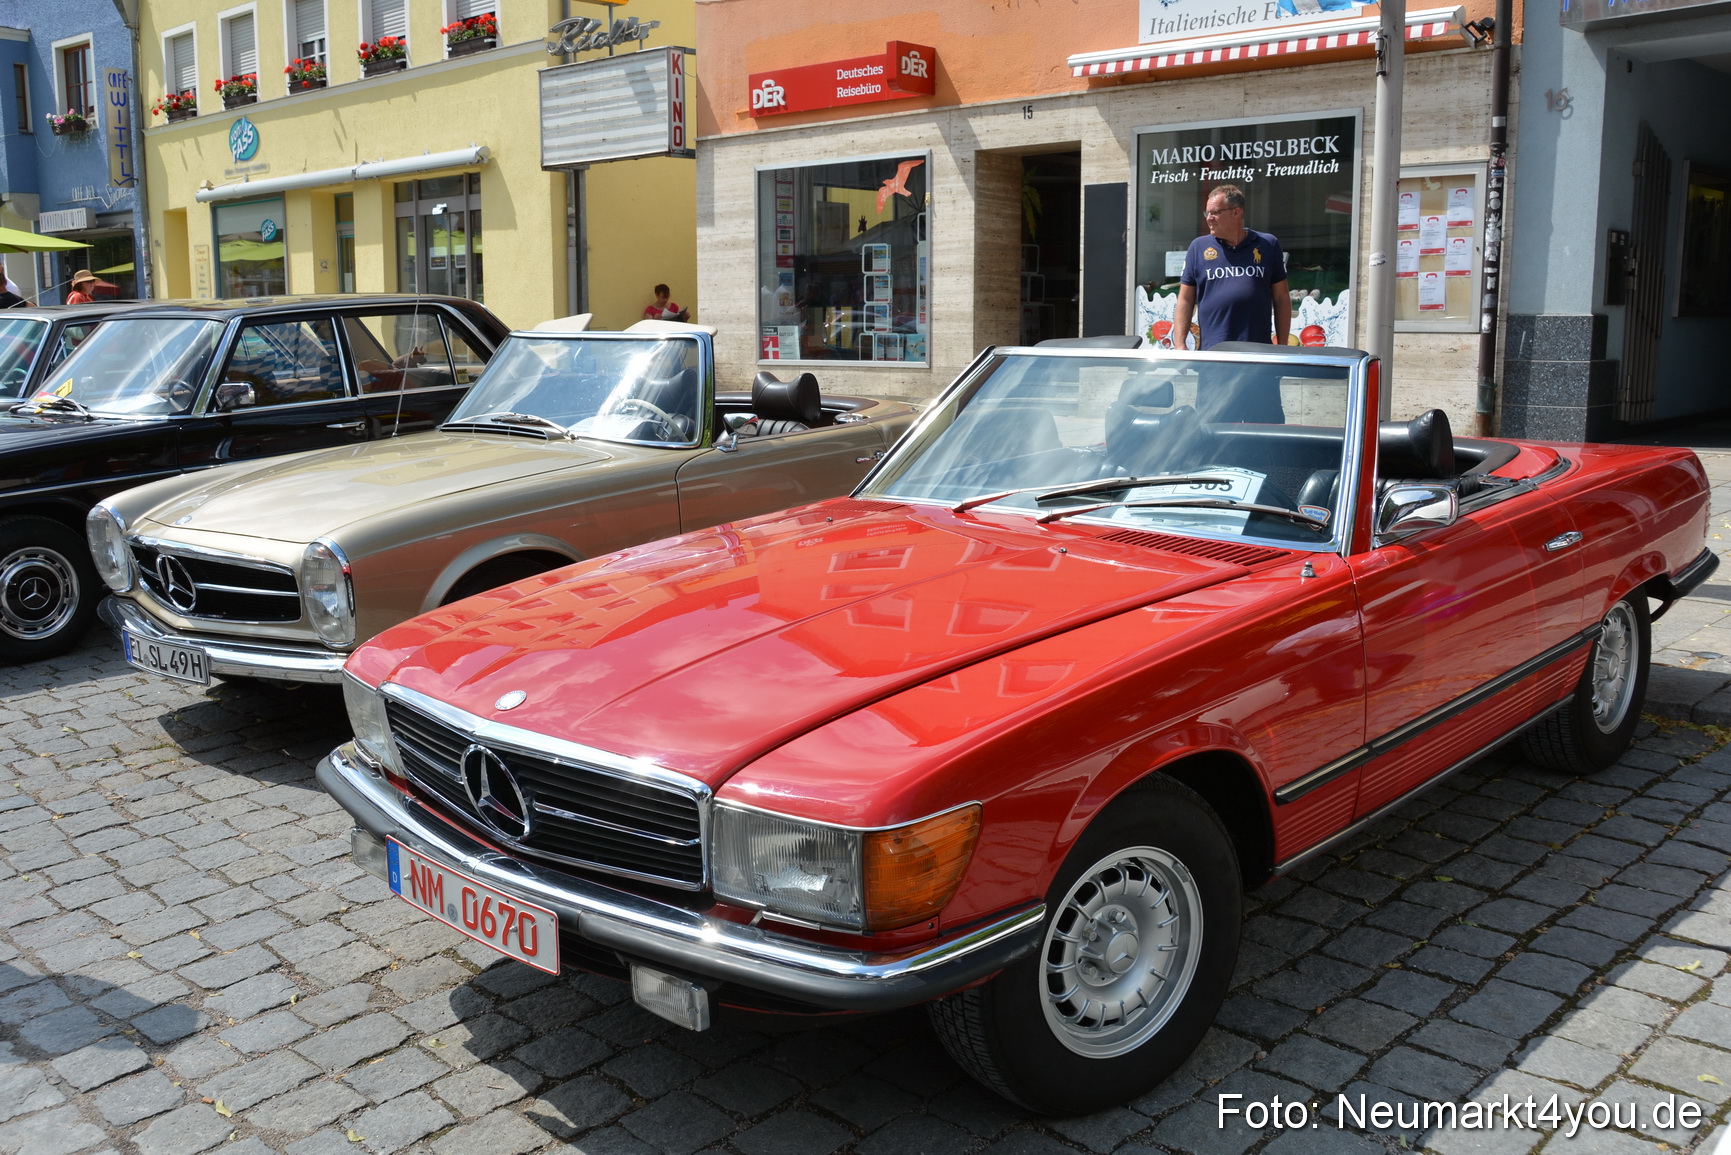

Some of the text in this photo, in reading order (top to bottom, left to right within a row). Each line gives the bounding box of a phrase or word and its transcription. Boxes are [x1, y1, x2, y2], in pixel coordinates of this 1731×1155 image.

[1148, 6, 1257, 36] Italienische
[107, 70, 128, 88] CAFÉ
[836, 64, 884, 80] Deutsches
[901, 55, 928, 79] DER
[671, 53, 683, 147] KINO
[752, 84, 786, 109] DER
[836, 83, 882, 98] Reisebüro
[1543, 87, 1568, 112] 16
[1021, 105, 1034, 121] 15
[110, 91, 131, 177] WITTL
[232, 123, 254, 164] FASS
[1151, 135, 1340, 166] MARIO NIESSLBECK
[1150, 159, 1340, 184] Frisch Fruchtig Freundlich
[1206, 265, 1265, 281] LONDON
[169, 650, 203, 679] 49H
[392, 871, 398, 883] D
[410, 857, 538, 957] NM 0670
